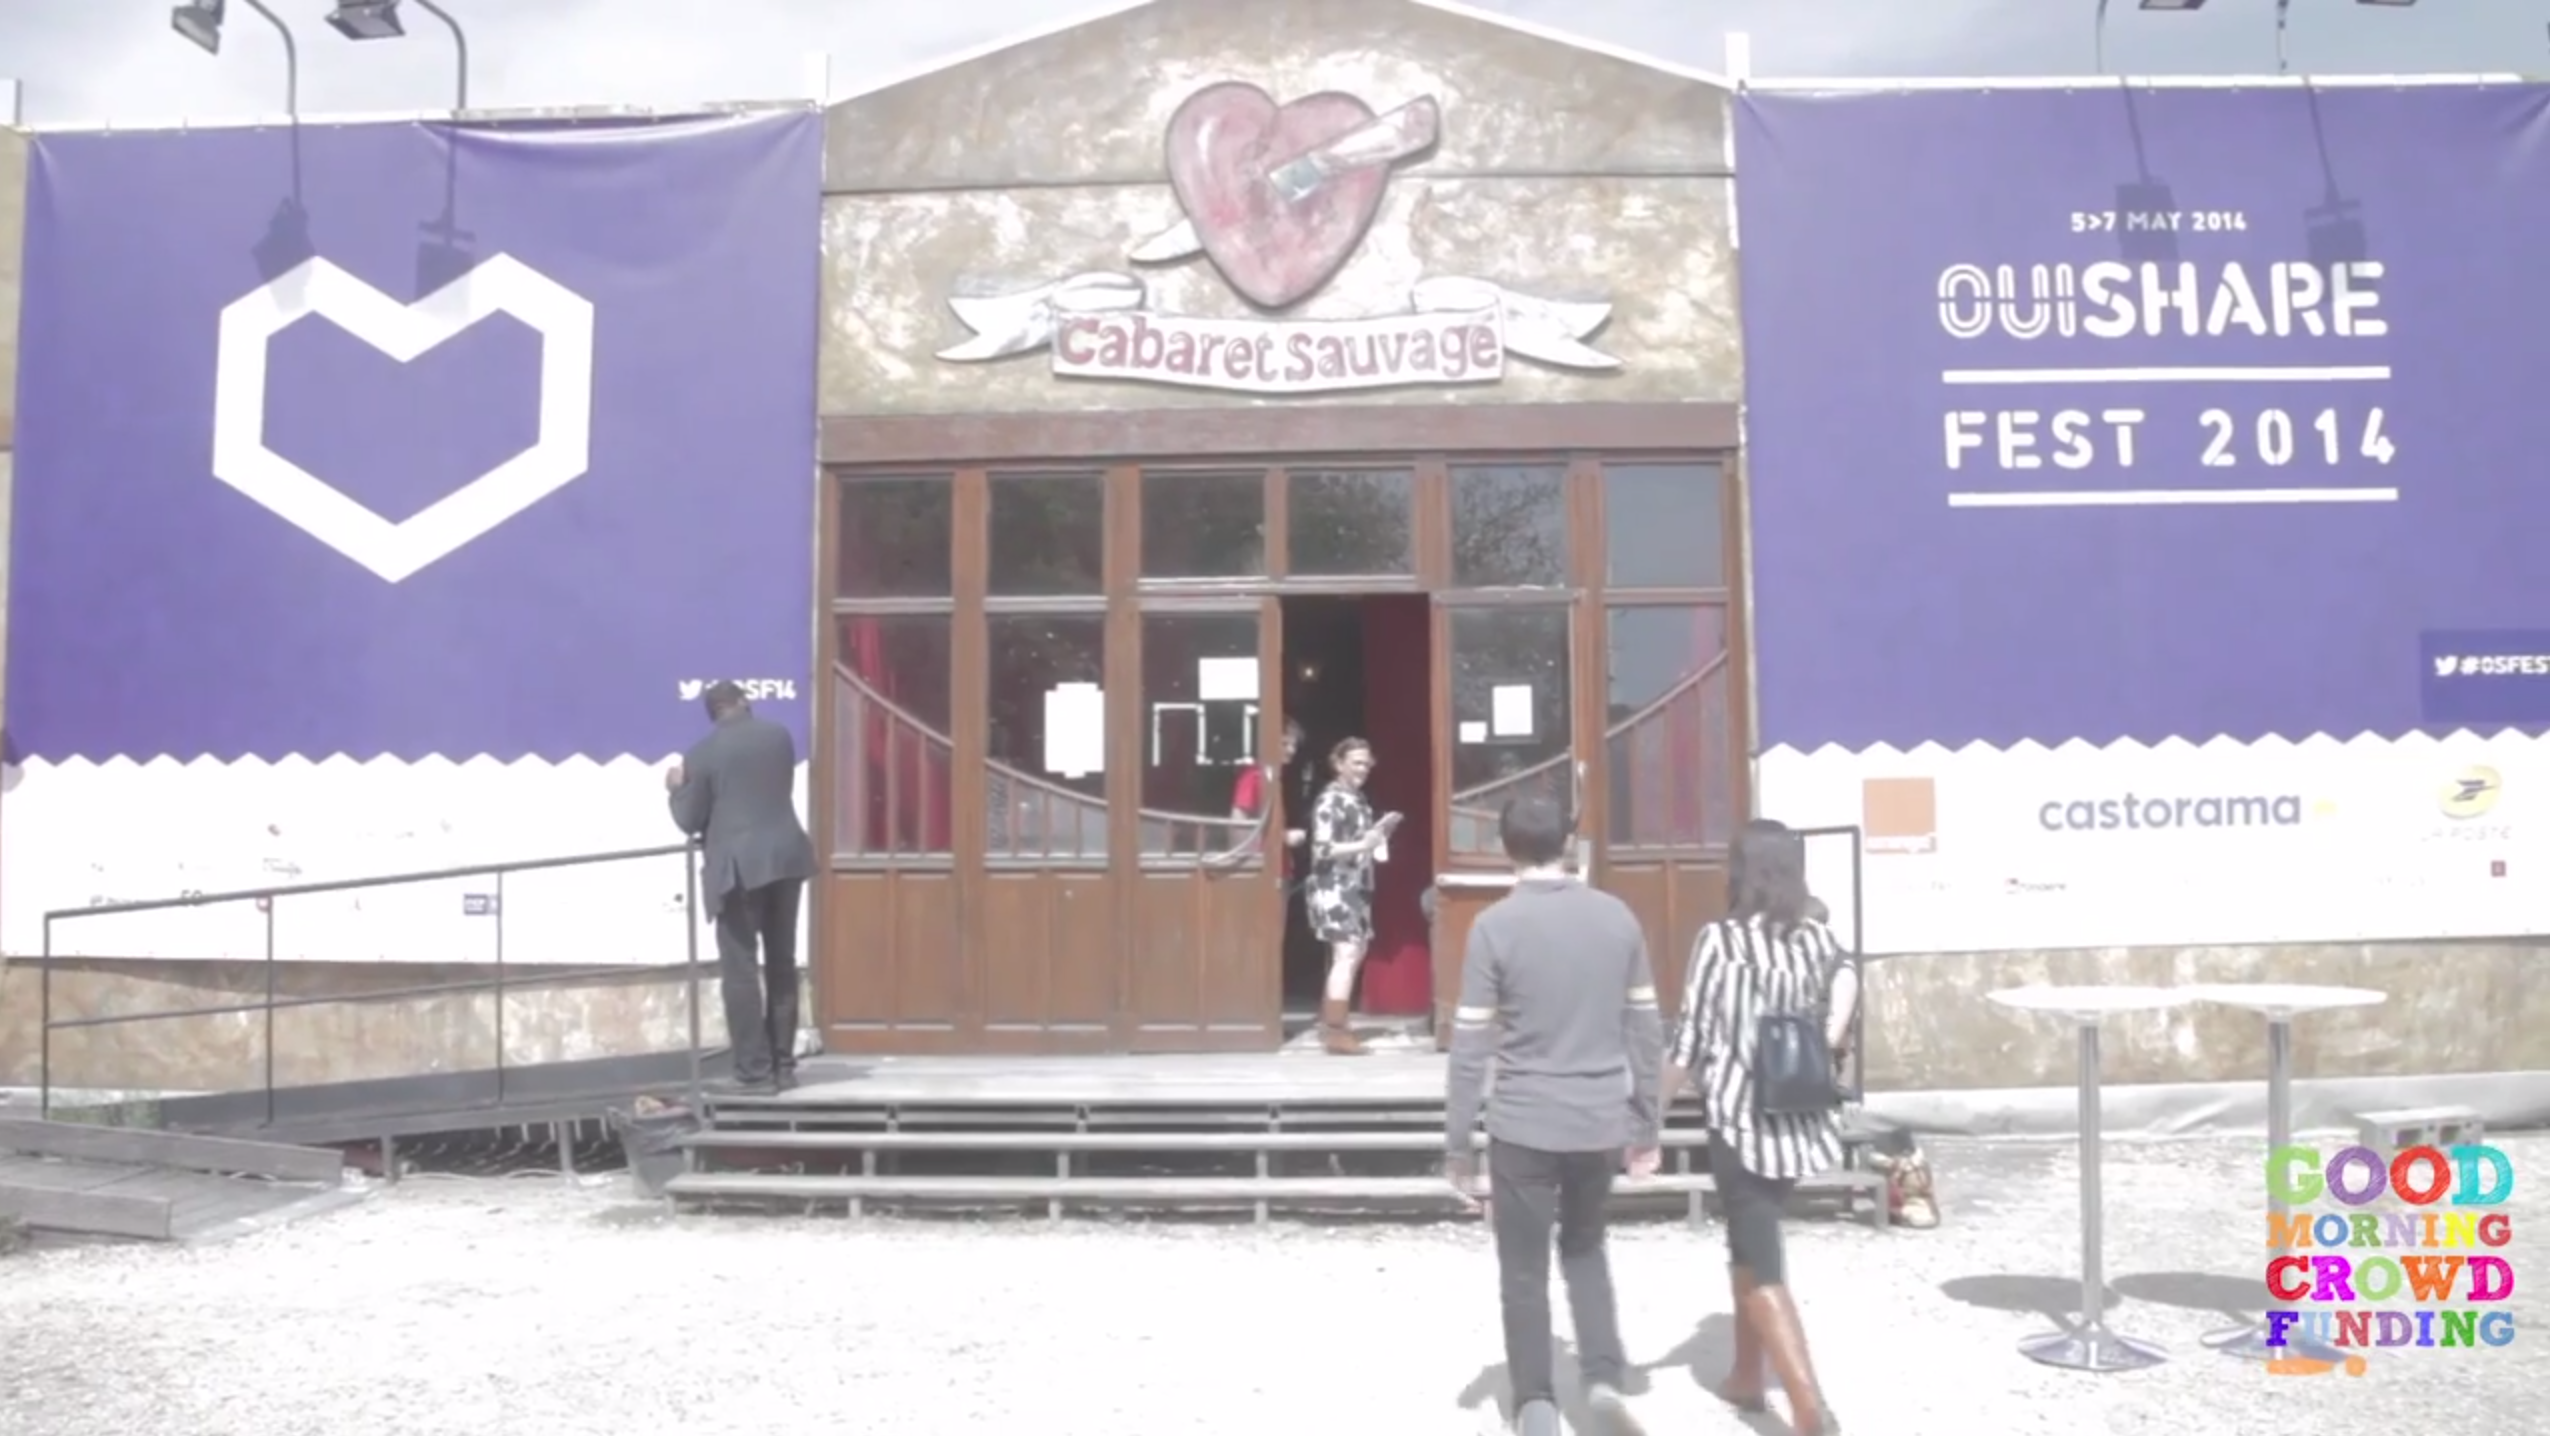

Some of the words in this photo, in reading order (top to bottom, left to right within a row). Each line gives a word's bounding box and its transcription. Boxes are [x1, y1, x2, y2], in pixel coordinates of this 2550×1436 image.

[2070, 211, 2117, 233] 5>7
[2126, 211, 2182, 232] MAY
[2191, 211, 2247, 232] 2014
[1938, 261, 2388, 339] OUISHARE
[1944, 408, 2145, 469] FEST
[2199, 407, 2396, 467] 2014
[2460, 655, 2550, 676] #OSFES
[2038, 792, 2301, 831] castorama
